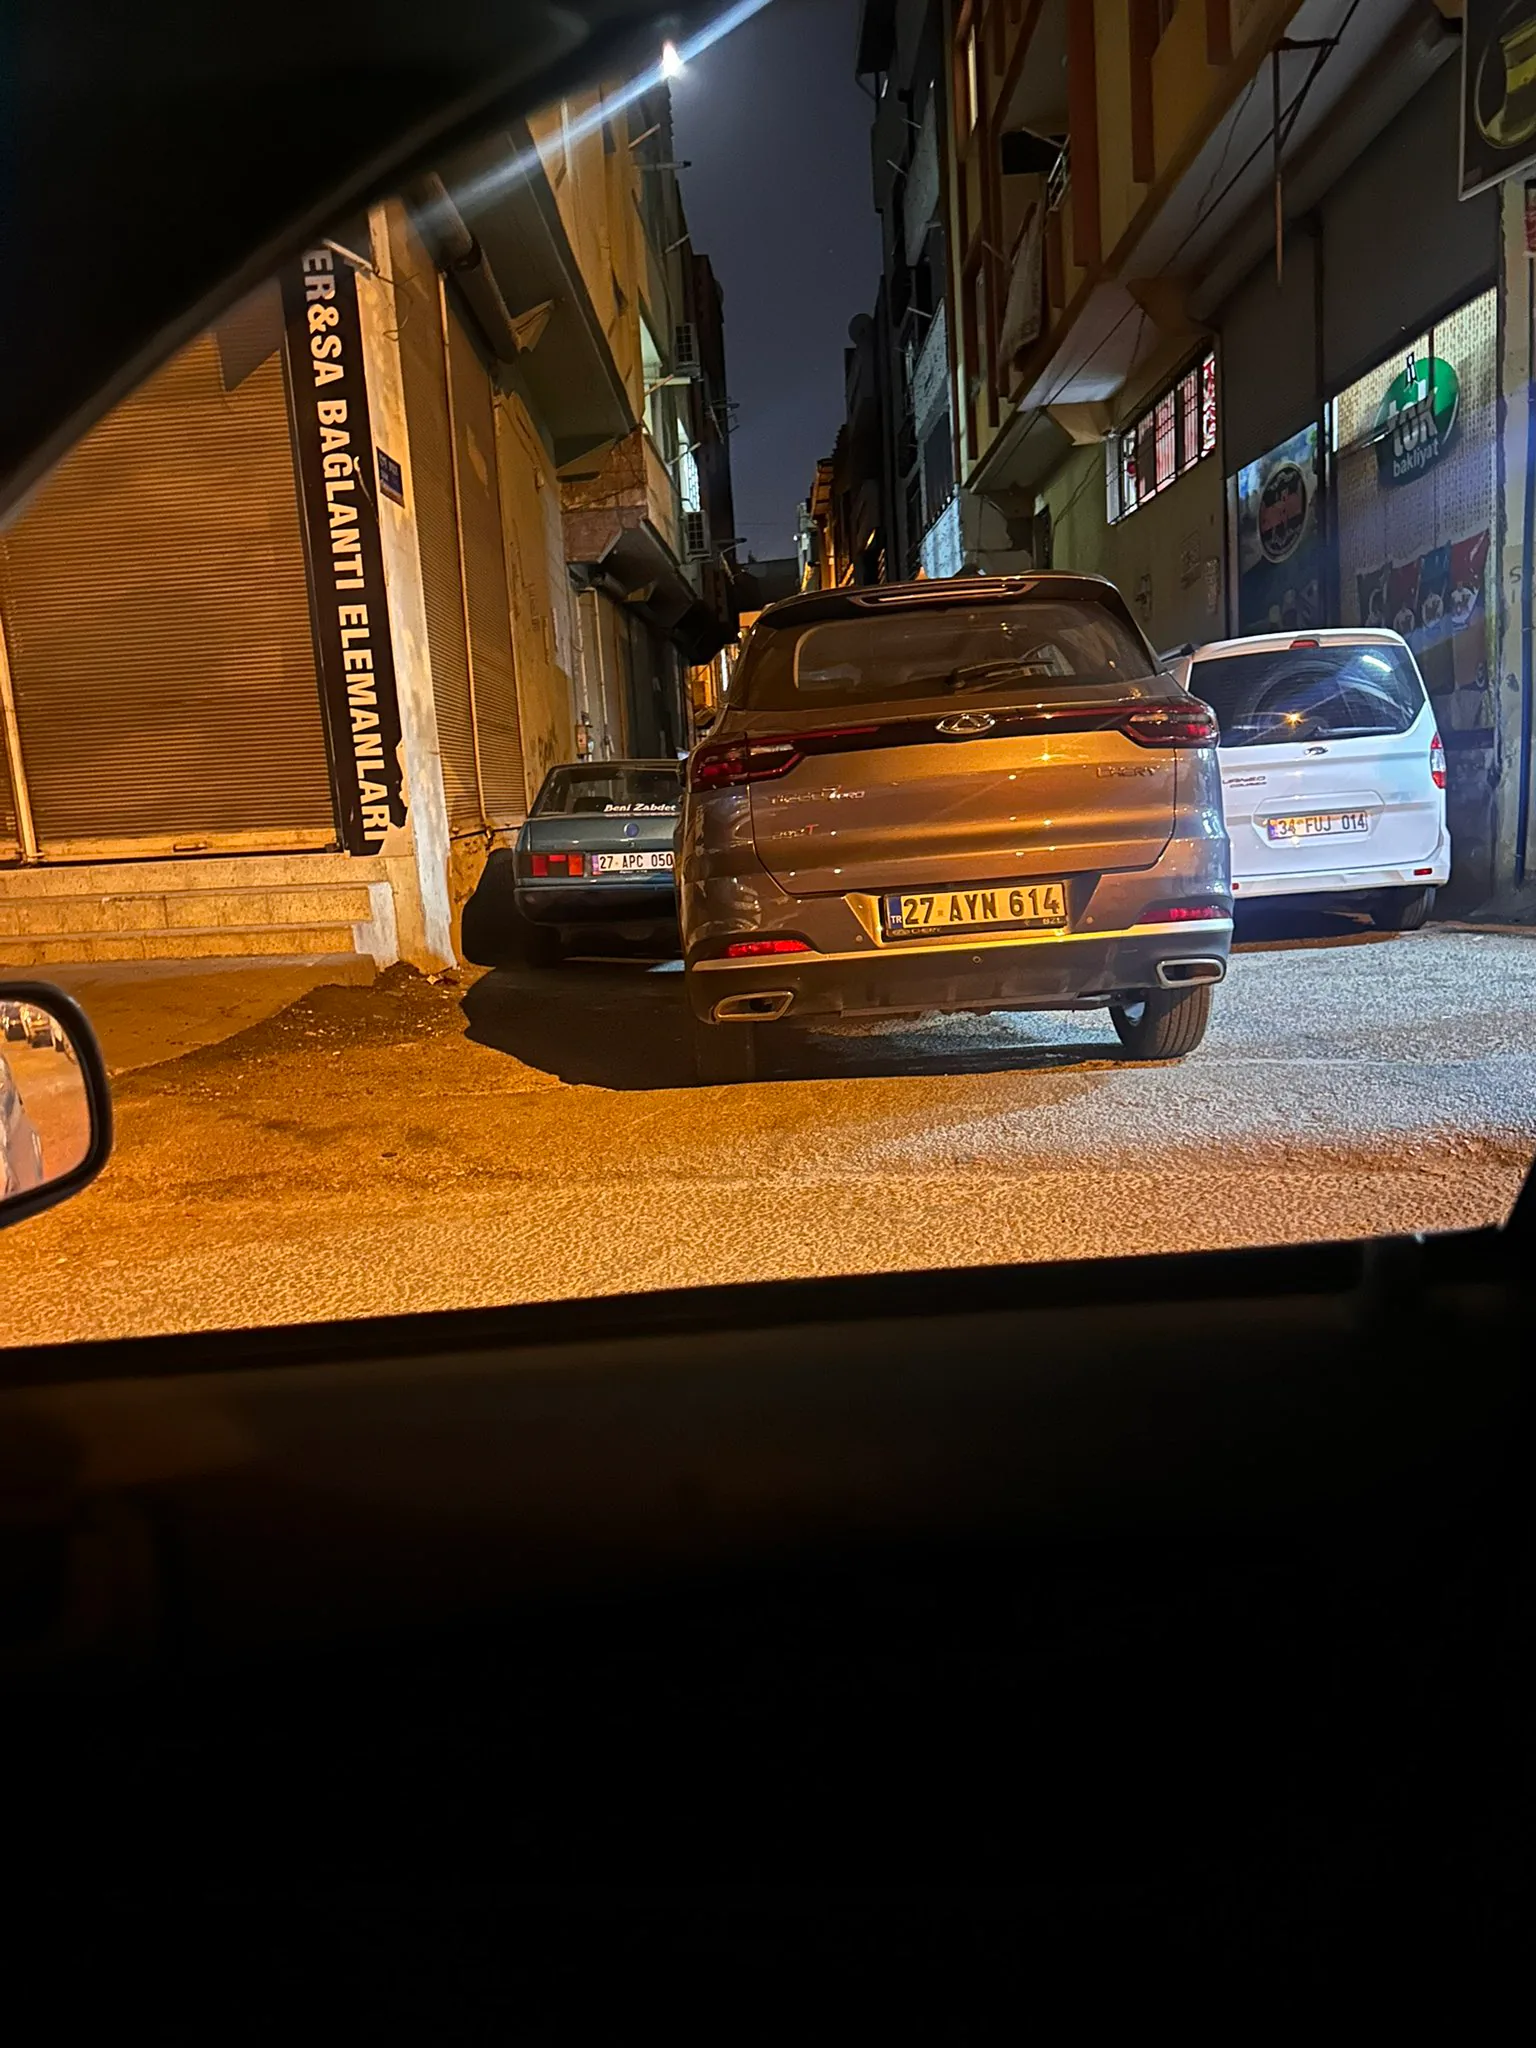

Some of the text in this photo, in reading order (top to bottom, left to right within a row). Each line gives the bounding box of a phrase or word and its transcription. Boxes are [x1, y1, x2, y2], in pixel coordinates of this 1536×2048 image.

[1393, 437, 1439, 477] bakliyat
[316, 399, 365, 590] BAĞLANTI
[337, 603, 391, 841] ELEMANLARI
[1278, 813, 1365, 835] 34 FUJ 014
[599, 853, 673, 870] 27 APC 050
[890, 915, 902, 924] TR
[903, 887, 1060, 925] 27 AYN 614
